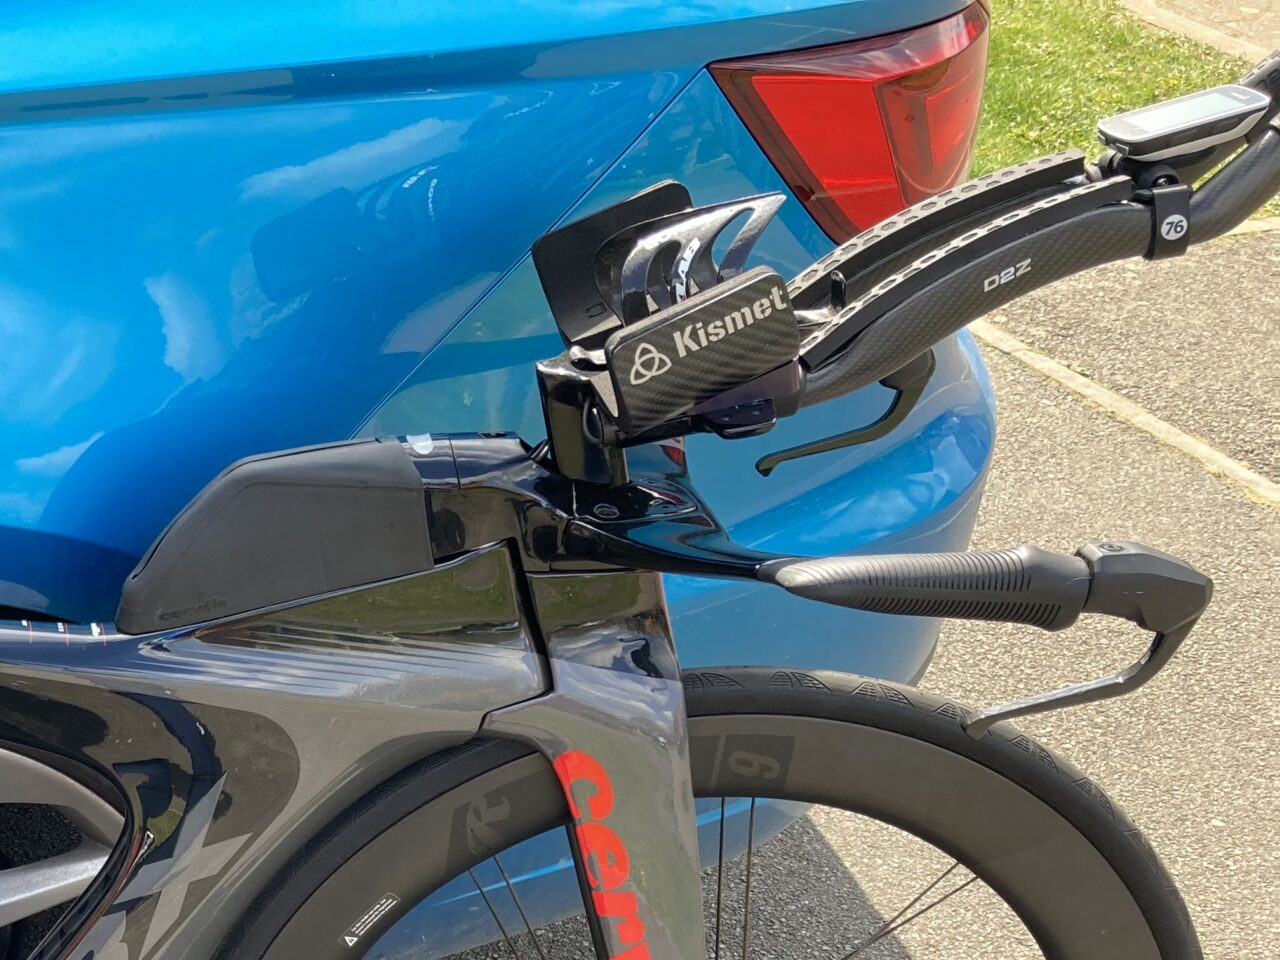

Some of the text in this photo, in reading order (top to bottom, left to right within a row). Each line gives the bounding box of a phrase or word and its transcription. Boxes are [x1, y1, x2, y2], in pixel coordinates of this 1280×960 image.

[1163, 219, 1185, 235] 76
[983, 258, 1032, 293] D2Z
[673, 286, 788, 358] Kismet
